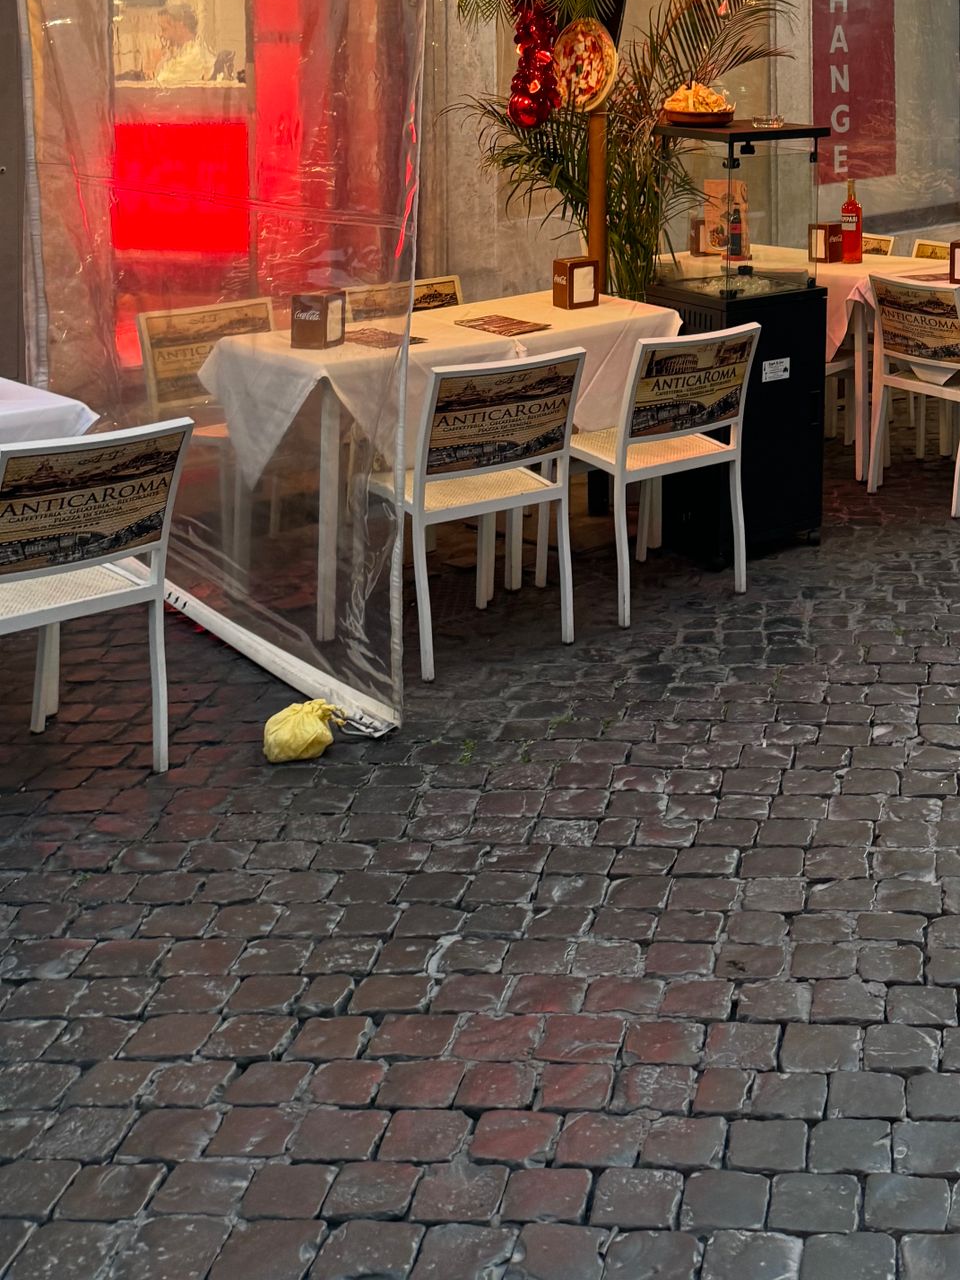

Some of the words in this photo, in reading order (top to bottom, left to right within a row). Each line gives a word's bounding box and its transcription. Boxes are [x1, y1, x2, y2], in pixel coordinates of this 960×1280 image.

[651, 367, 736, 391] ANTICAROMA
[437, 398, 567, 427] ANTICAROMA
[1, 477, 168, 518] ANTICAROMA
